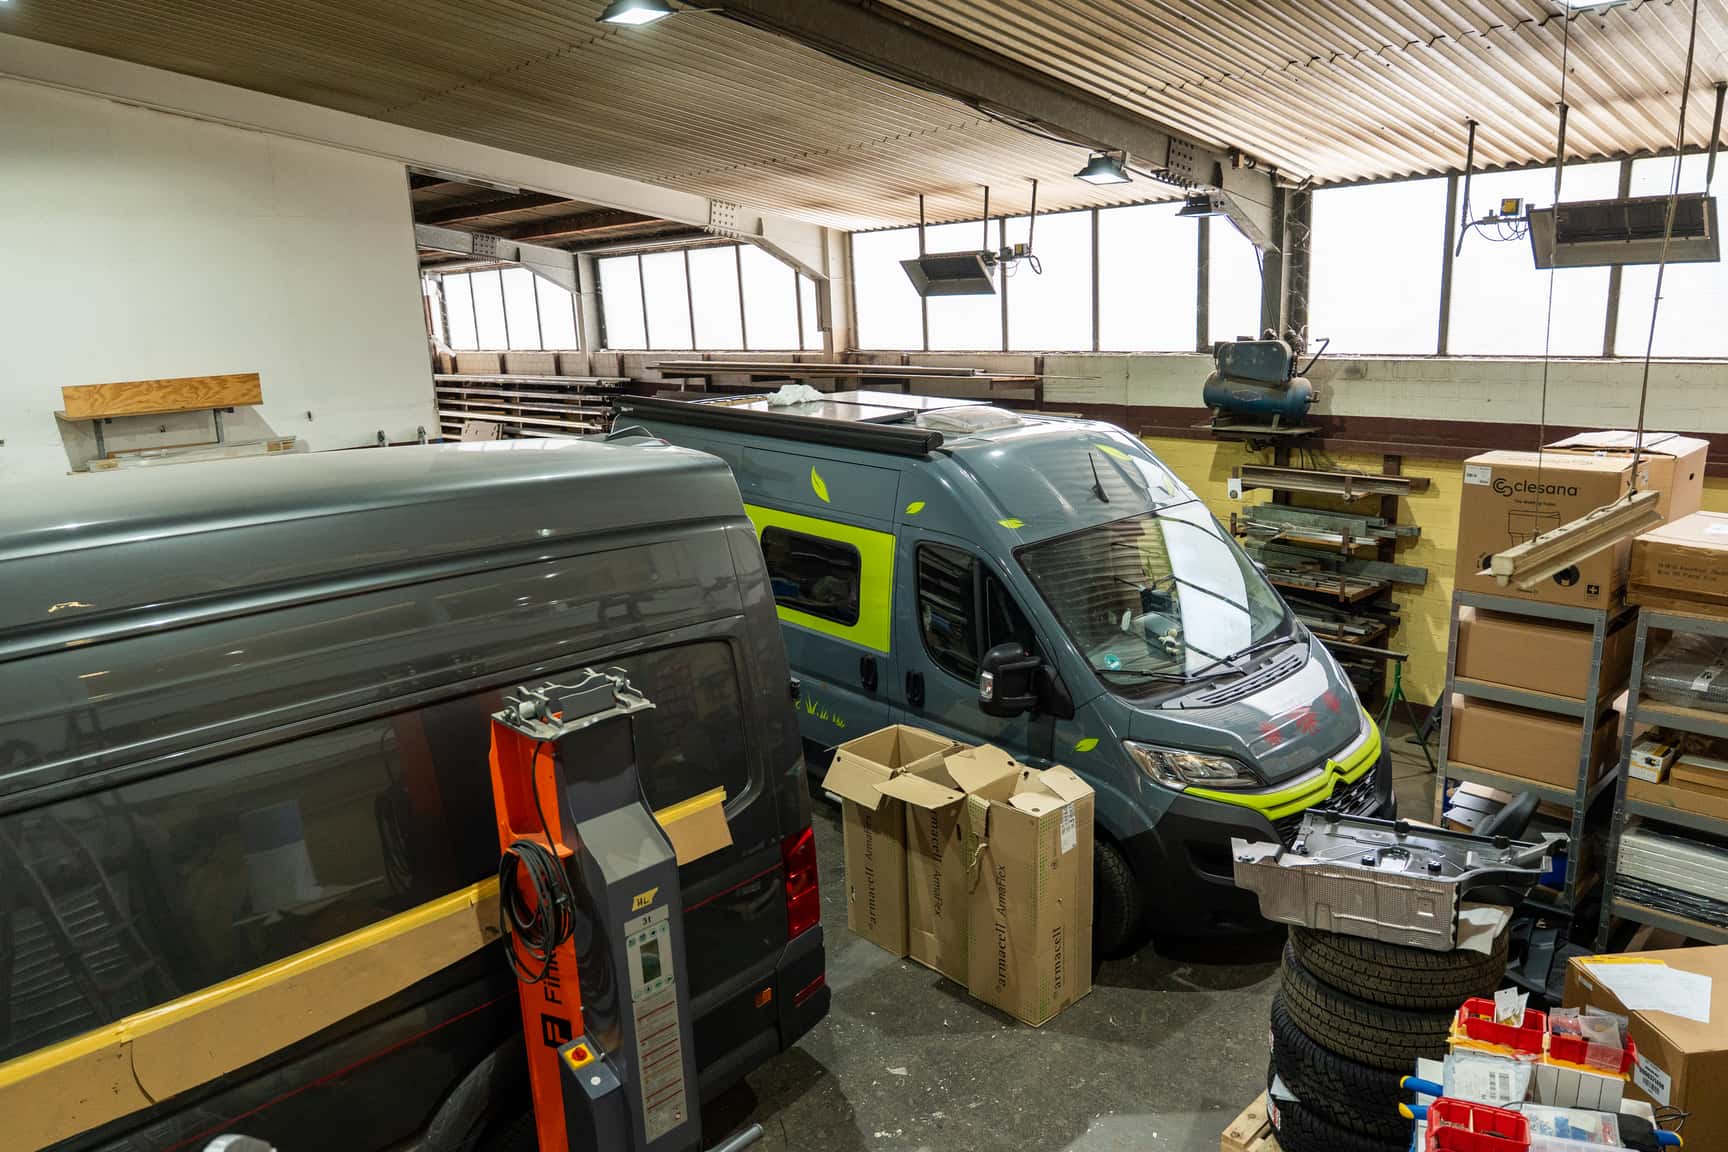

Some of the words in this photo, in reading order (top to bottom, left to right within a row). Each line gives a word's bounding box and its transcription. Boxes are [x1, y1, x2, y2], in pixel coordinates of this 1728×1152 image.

[1514, 480, 1578, 496] clesana
[865, 866, 877, 925] armacell
[997, 864, 1007, 918] ArmaFlex
[996, 923, 1007, 987] armacell
[1052, 926, 1062, 989] armacell
